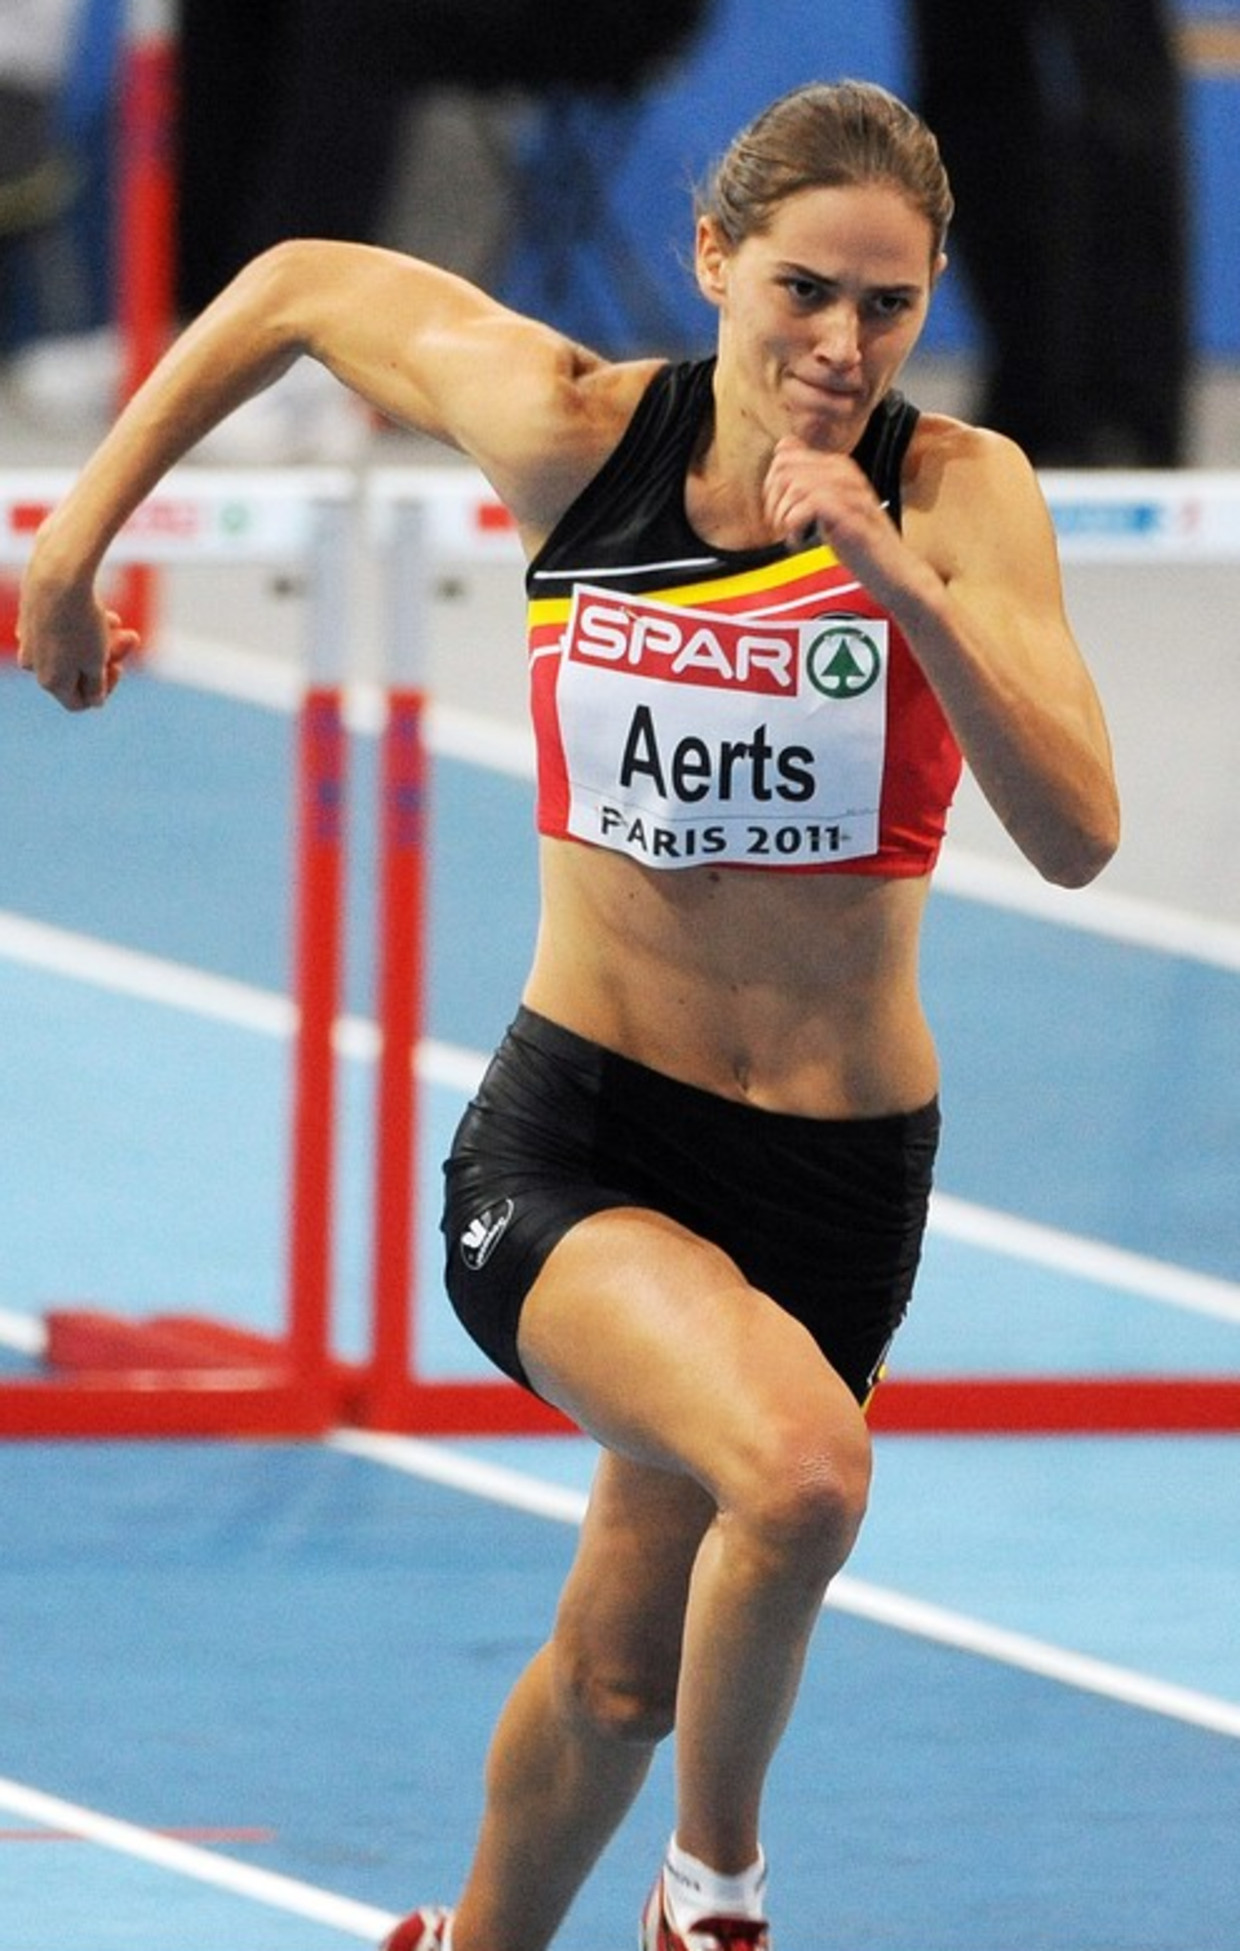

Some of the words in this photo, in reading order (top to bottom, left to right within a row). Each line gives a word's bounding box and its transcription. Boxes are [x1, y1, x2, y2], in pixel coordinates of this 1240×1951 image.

[577, 604, 792, 687] SPAR
[619, 704, 816, 802] Aerts
[601, 806, 727, 858] PARIS
[746, 825, 841, 855] 2011
